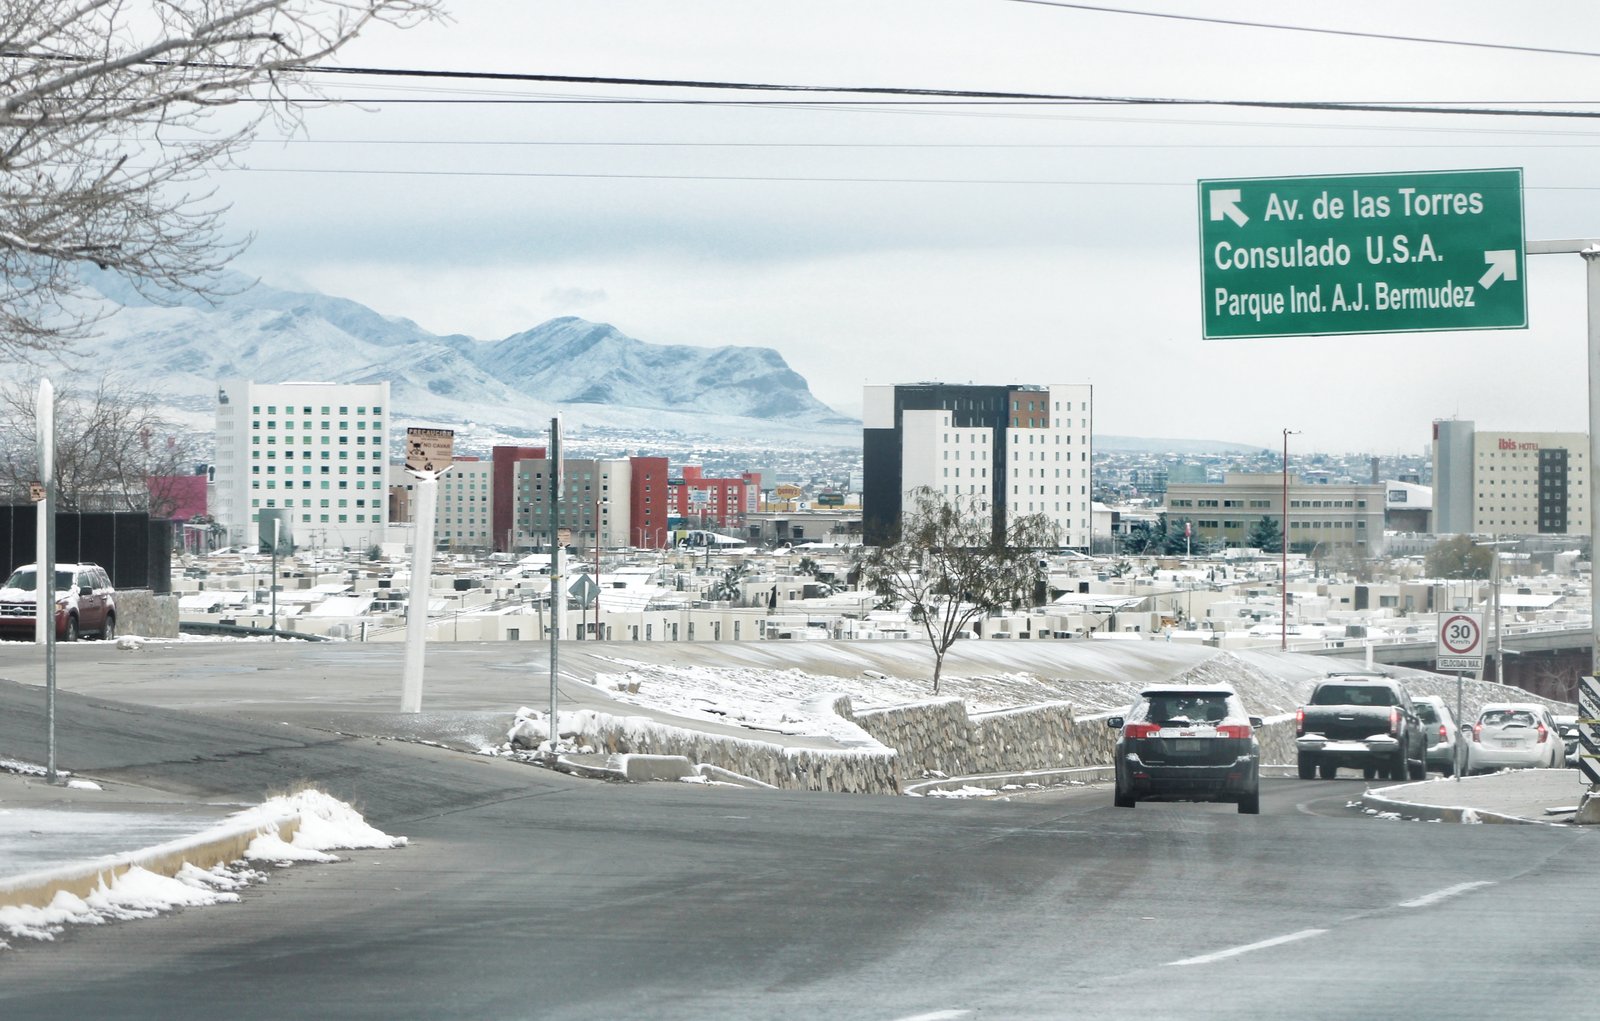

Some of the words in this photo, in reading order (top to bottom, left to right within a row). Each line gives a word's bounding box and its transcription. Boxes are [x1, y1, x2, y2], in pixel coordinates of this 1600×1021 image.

[1264, 192, 1304, 222] Av.
[1312, 190, 1344, 220] de
[1353, 189, 1391, 218] las
[1398, 187, 1484, 217] Torres
[1214, 237, 1351, 271] Consulado
[1366, 233, 1444, 265] U.S.A.
[1215, 287, 1285, 322] Parque
[1290, 284, 1327, 314] Ind.
[1331, 282, 1370, 312] A.J.
[1375, 279, 1476, 311] Bermudez
[1498, 438, 1517, 450] ibis
[1518, 443, 1539, 451] HOTEL
[1450, 624, 1471, 639] 30
